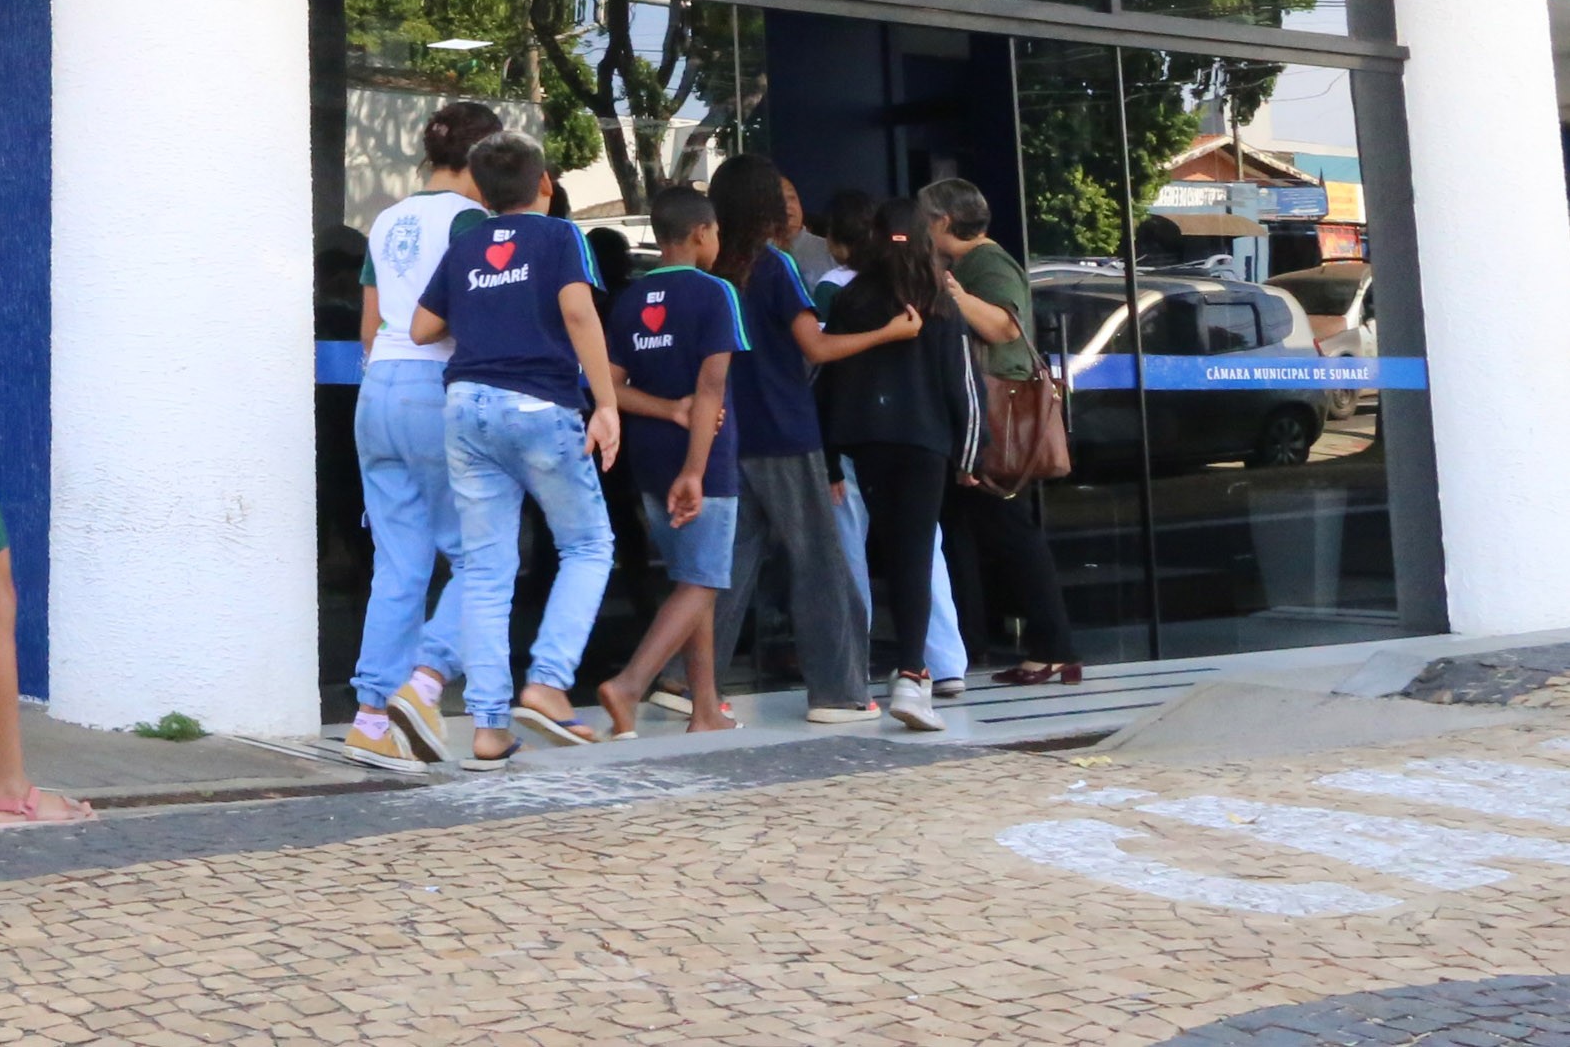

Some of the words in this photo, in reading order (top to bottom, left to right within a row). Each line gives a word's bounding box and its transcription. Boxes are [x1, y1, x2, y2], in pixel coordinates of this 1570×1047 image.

[493, 229, 516, 242] EU
[467, 263, 529, 291] SUMARÉ
[646, 290, 666, 304] EU
[1206, 365, 1250, 380] CÂMARA
[1254, 367, 1310, 380] MUNICIPAL
[1313, 368, 1326, 379] DE
[1329, 366, 1369, 380] SUMARÉ
